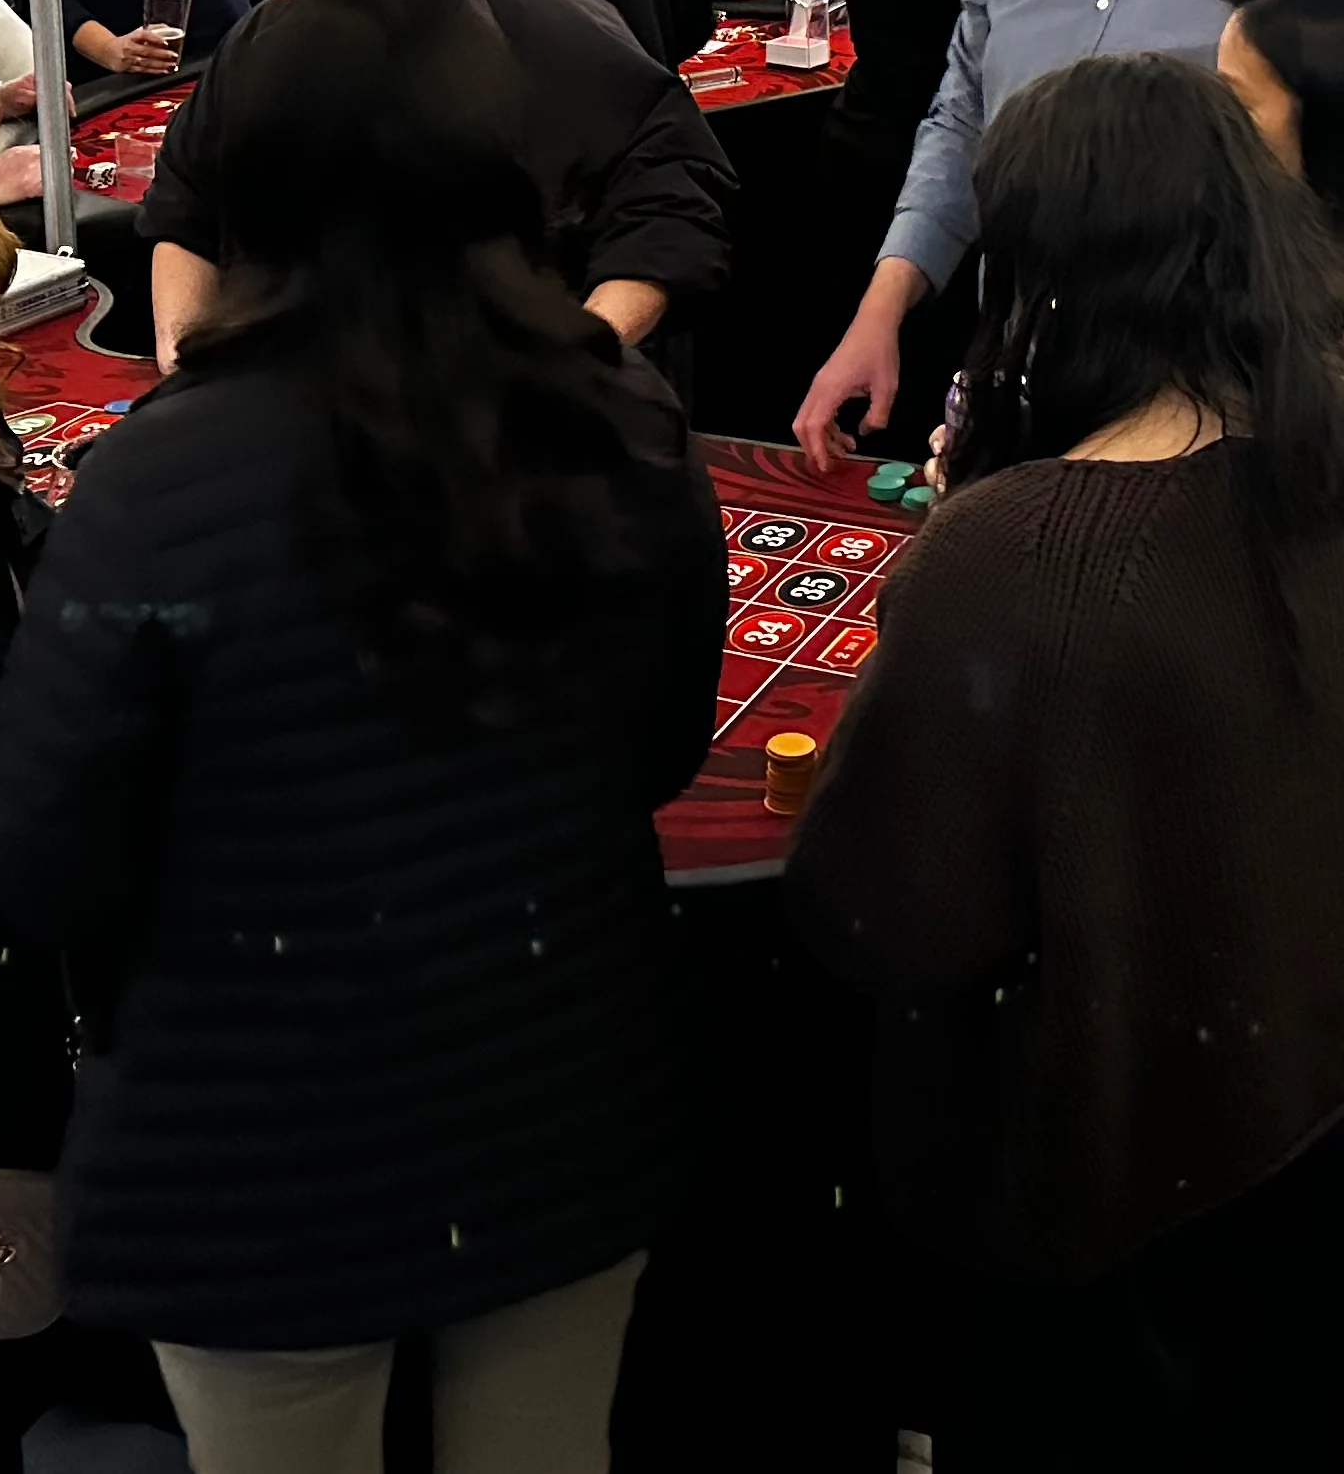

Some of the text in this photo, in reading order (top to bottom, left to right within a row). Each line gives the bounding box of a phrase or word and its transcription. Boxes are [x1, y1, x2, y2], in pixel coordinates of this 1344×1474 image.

[751, 525, 796, 547] 33
[830, 537, 874, 560] 36
[790, 576, 836, 601] 35
[743, 620, 793, 646] 34
